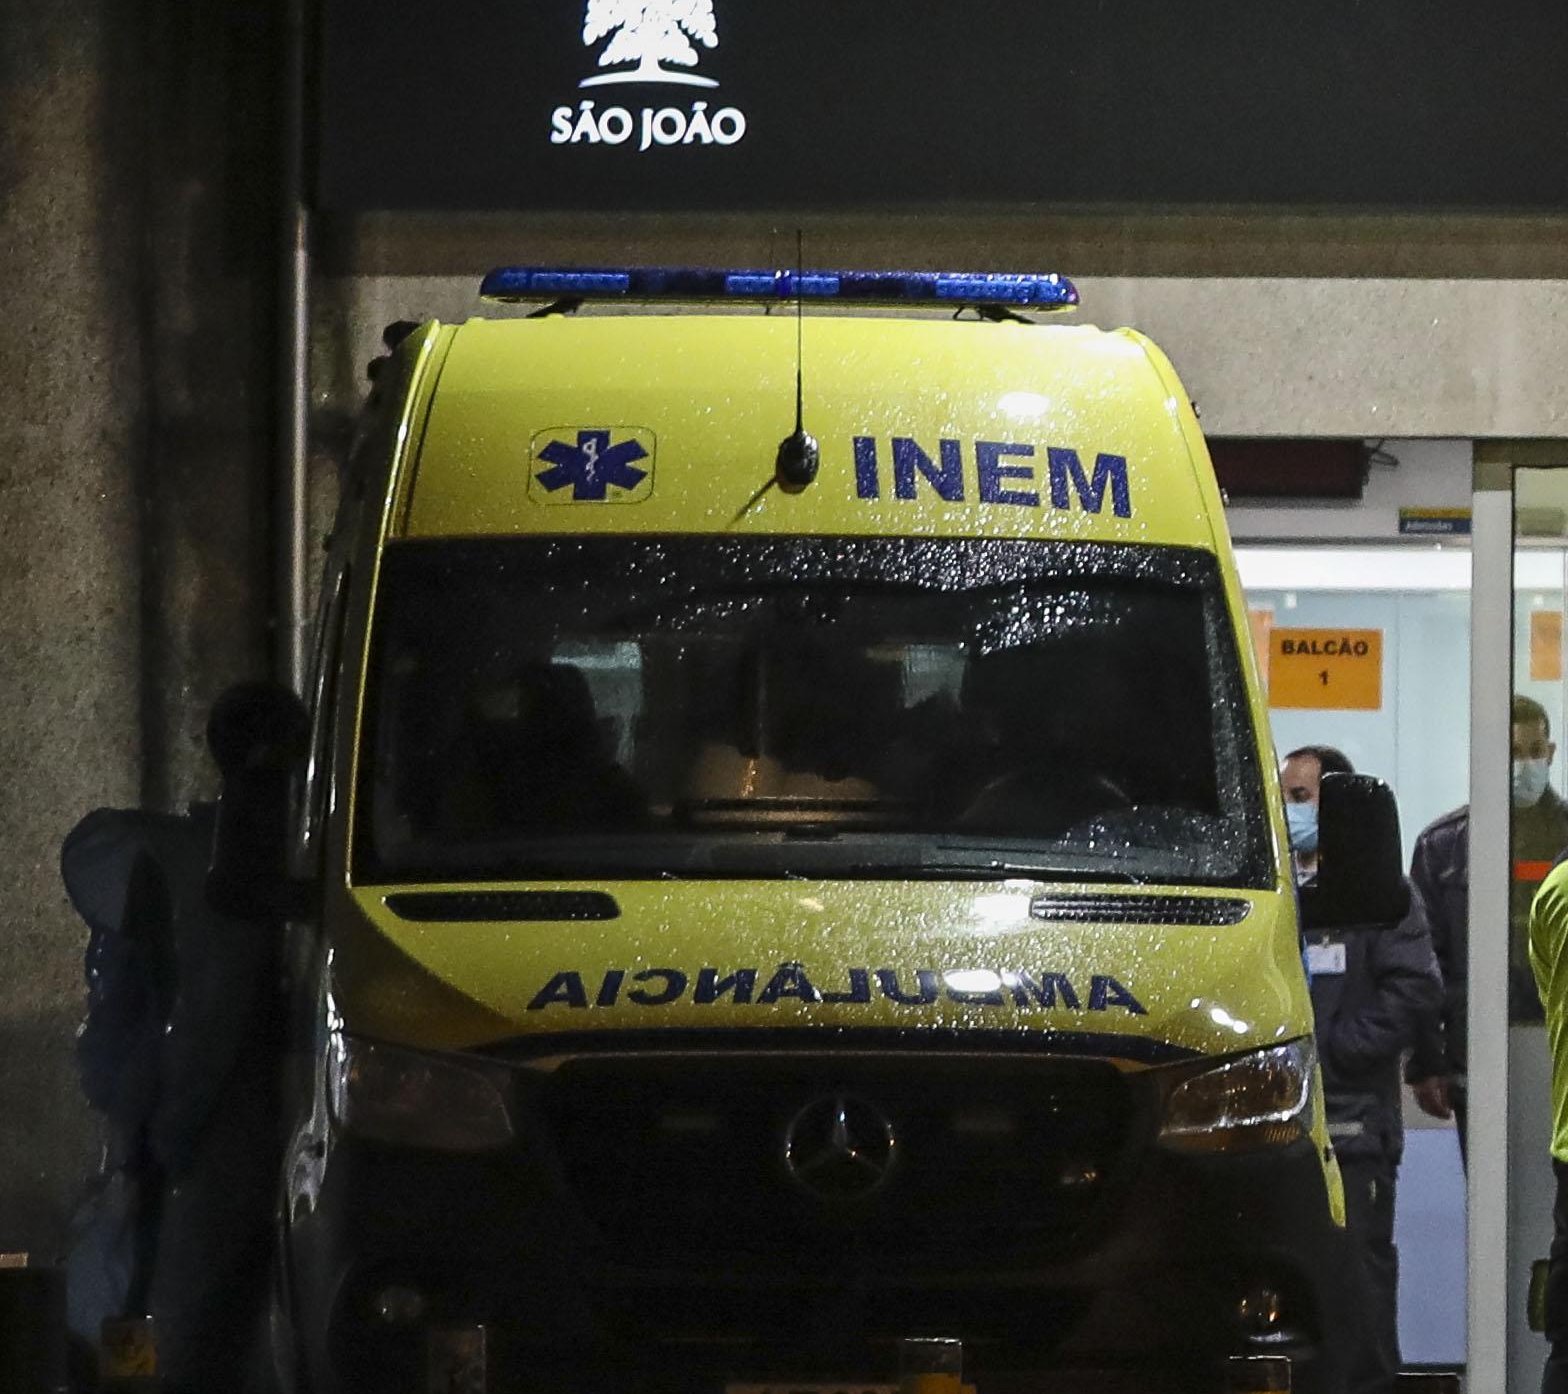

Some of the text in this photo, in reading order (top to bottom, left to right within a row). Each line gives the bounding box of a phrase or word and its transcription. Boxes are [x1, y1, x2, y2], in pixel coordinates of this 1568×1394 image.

[550, 101, 746, 151] SÃO JOÃO
[853, 435, 1132, 518] INEM
[1281, 637, 1369, 656] BALCÃO
[1319, 671, 1328, 685] 1
